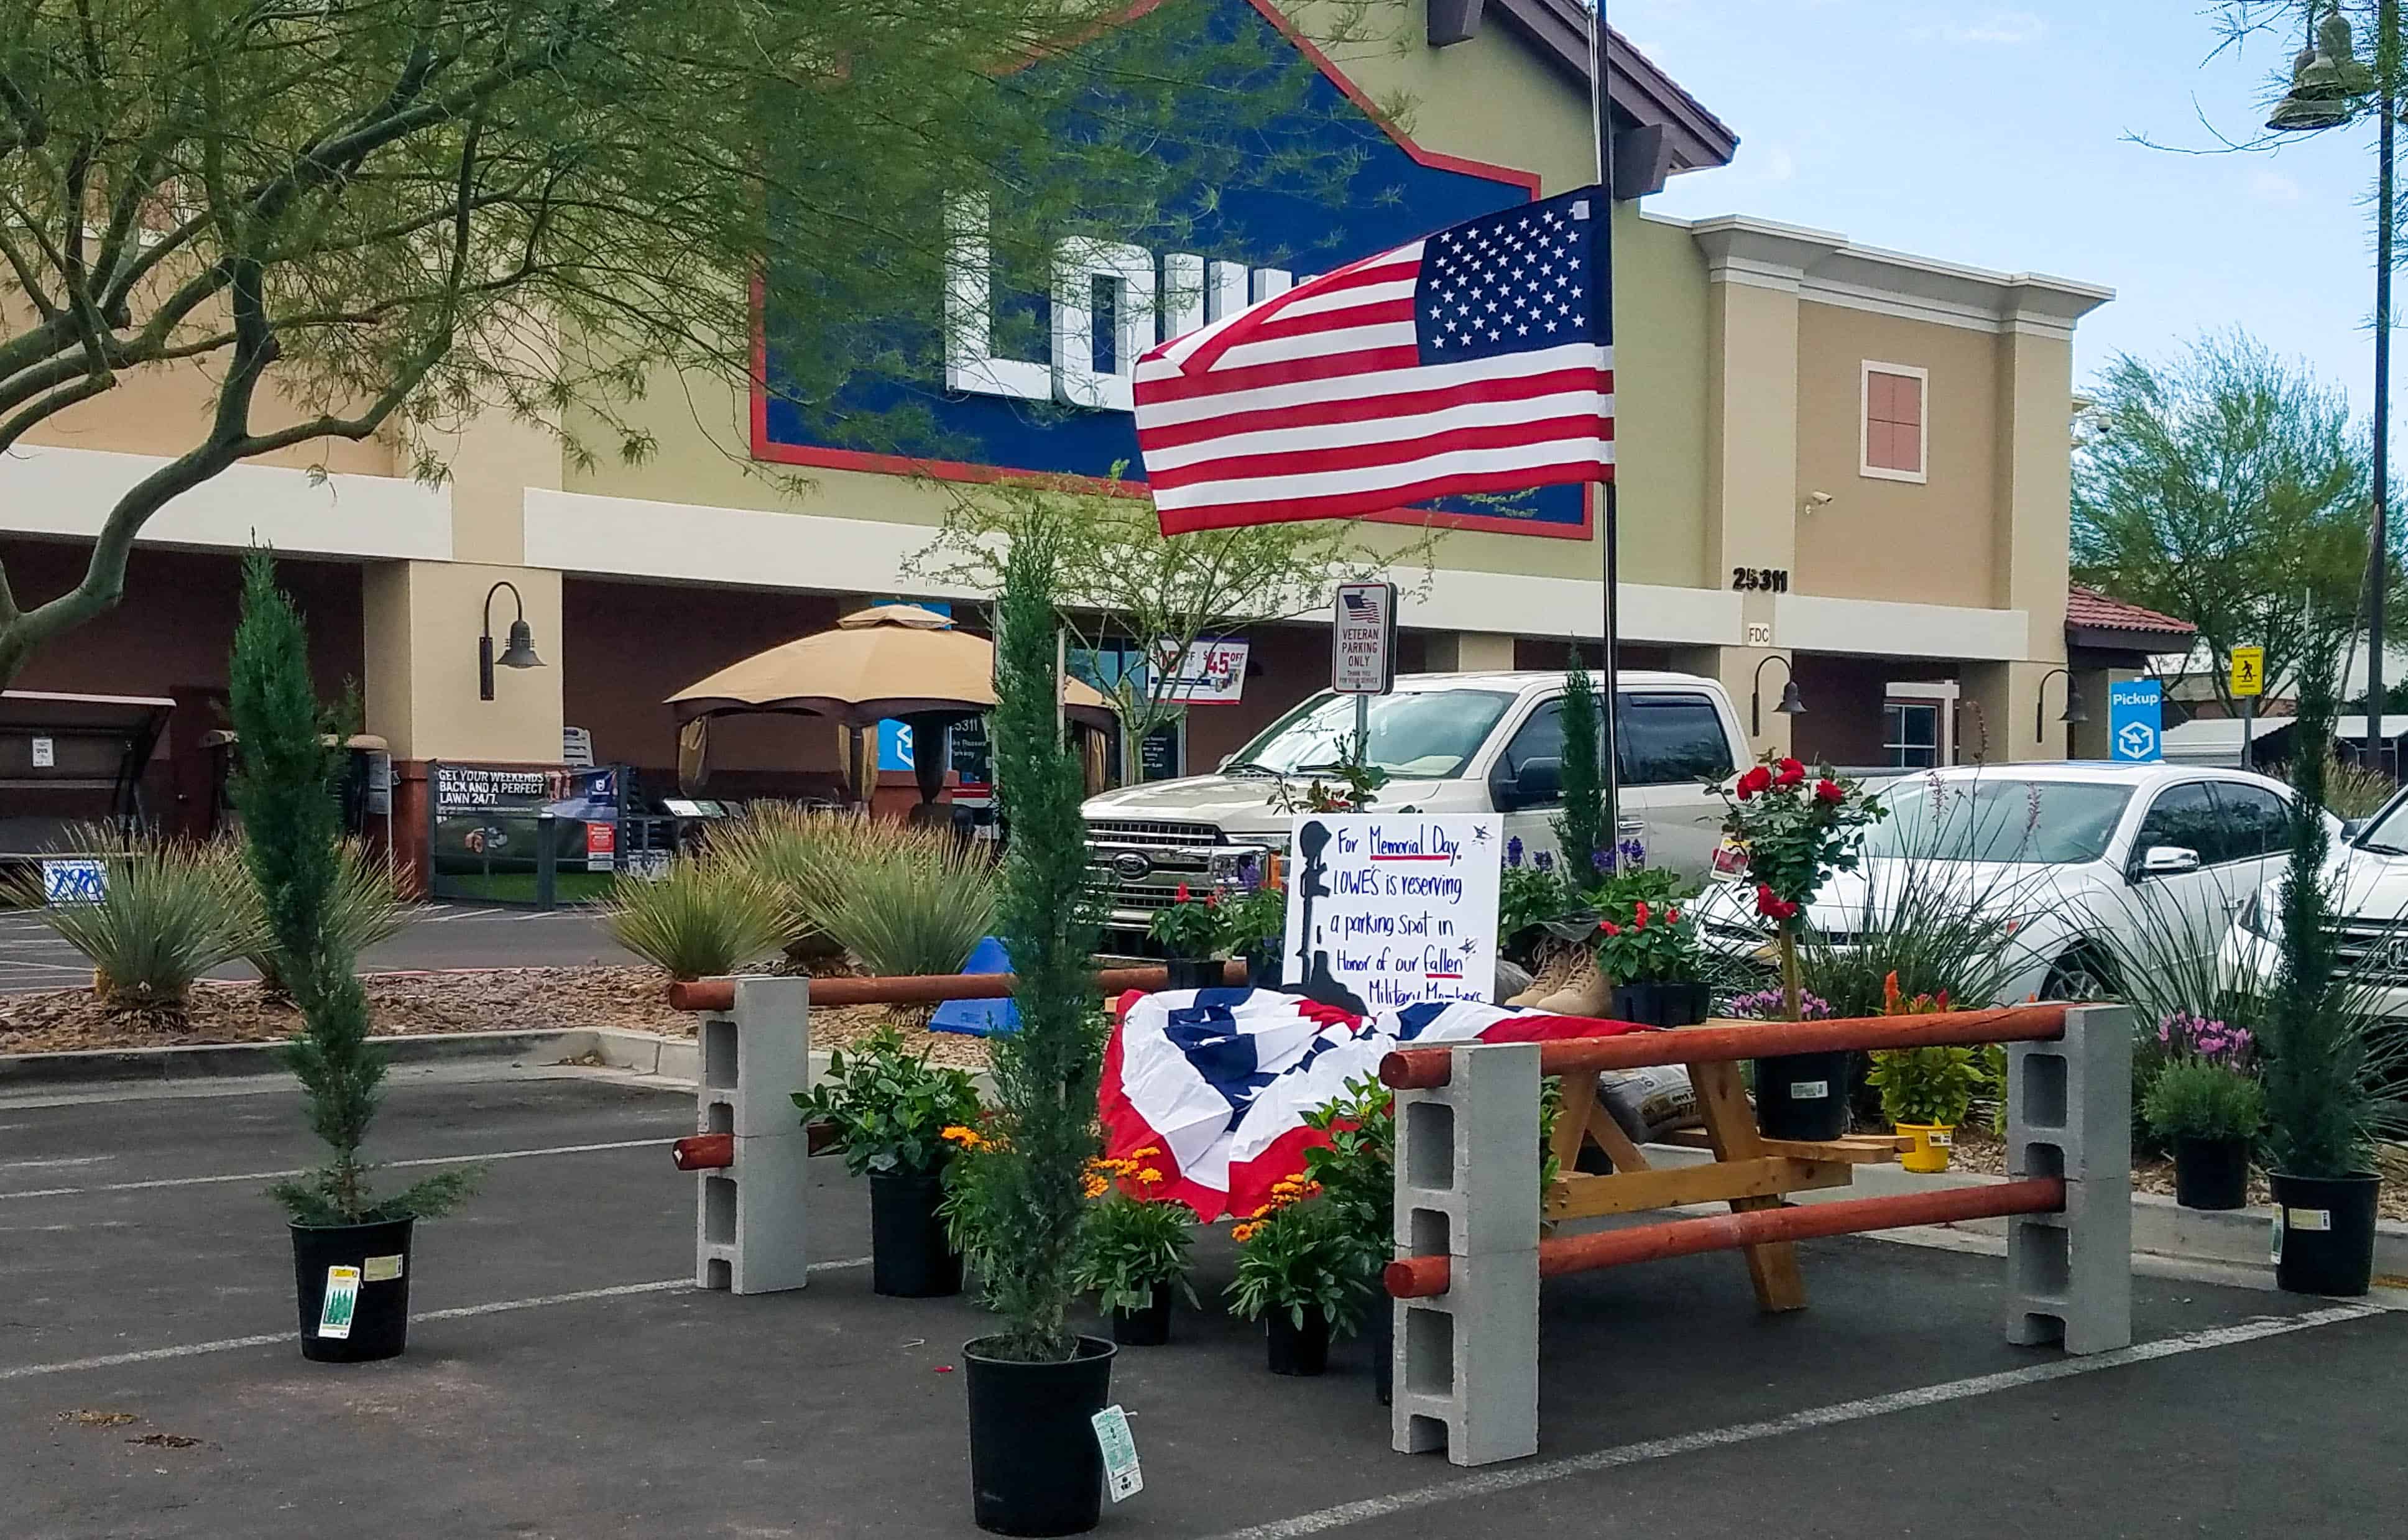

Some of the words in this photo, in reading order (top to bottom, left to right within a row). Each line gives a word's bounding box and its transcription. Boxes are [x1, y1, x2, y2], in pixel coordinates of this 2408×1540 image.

[1733, 567, 1788, 593] 25311
[1343, 628, 1379, 640] VETERAN
[1749, 628, 1769, 642] FDC
[1342, 642, 1378, 653] PARKING
[1203, 650, 1229, 674] $45
[1230, 653, 1244, 662] OFF
[1348, 655, 1370, 667] ONLY
[2113, 692, 2159, 706] Pickup
[951, 719, 978, 732] 5311
[438, 770, 458, 781] GET
[459, 770, 488, 782] YOUR
[490, 772, 544, 783] WEEKENDS
[439, 782, 467, 792] BACK
[469, 782, 489, 793] AND
[491, 783, 499, 793] A
[501, 783, 544, 794] PERFECT
[440, 793, 469, 805] LAWN
[472, 793, 499, 805] 24/7.
[1339, 828, 1358, 854] For
[1370, 824, 1424, 855] Memorial
[1386, 874, 1397, 895] is
[1402, 874, 1462, 905] reserving
[1331, 915, 1339, 933] a
[1345, 911, 1393, 941] parking
[1439, 918, 1454, 936] in
[1337, 949, 1372, 971] Honor
[1376, 946, 1391, 971] of
[1396, 956, 1419, 972] our
[1426, 982, 1483, 1003] Mbers
